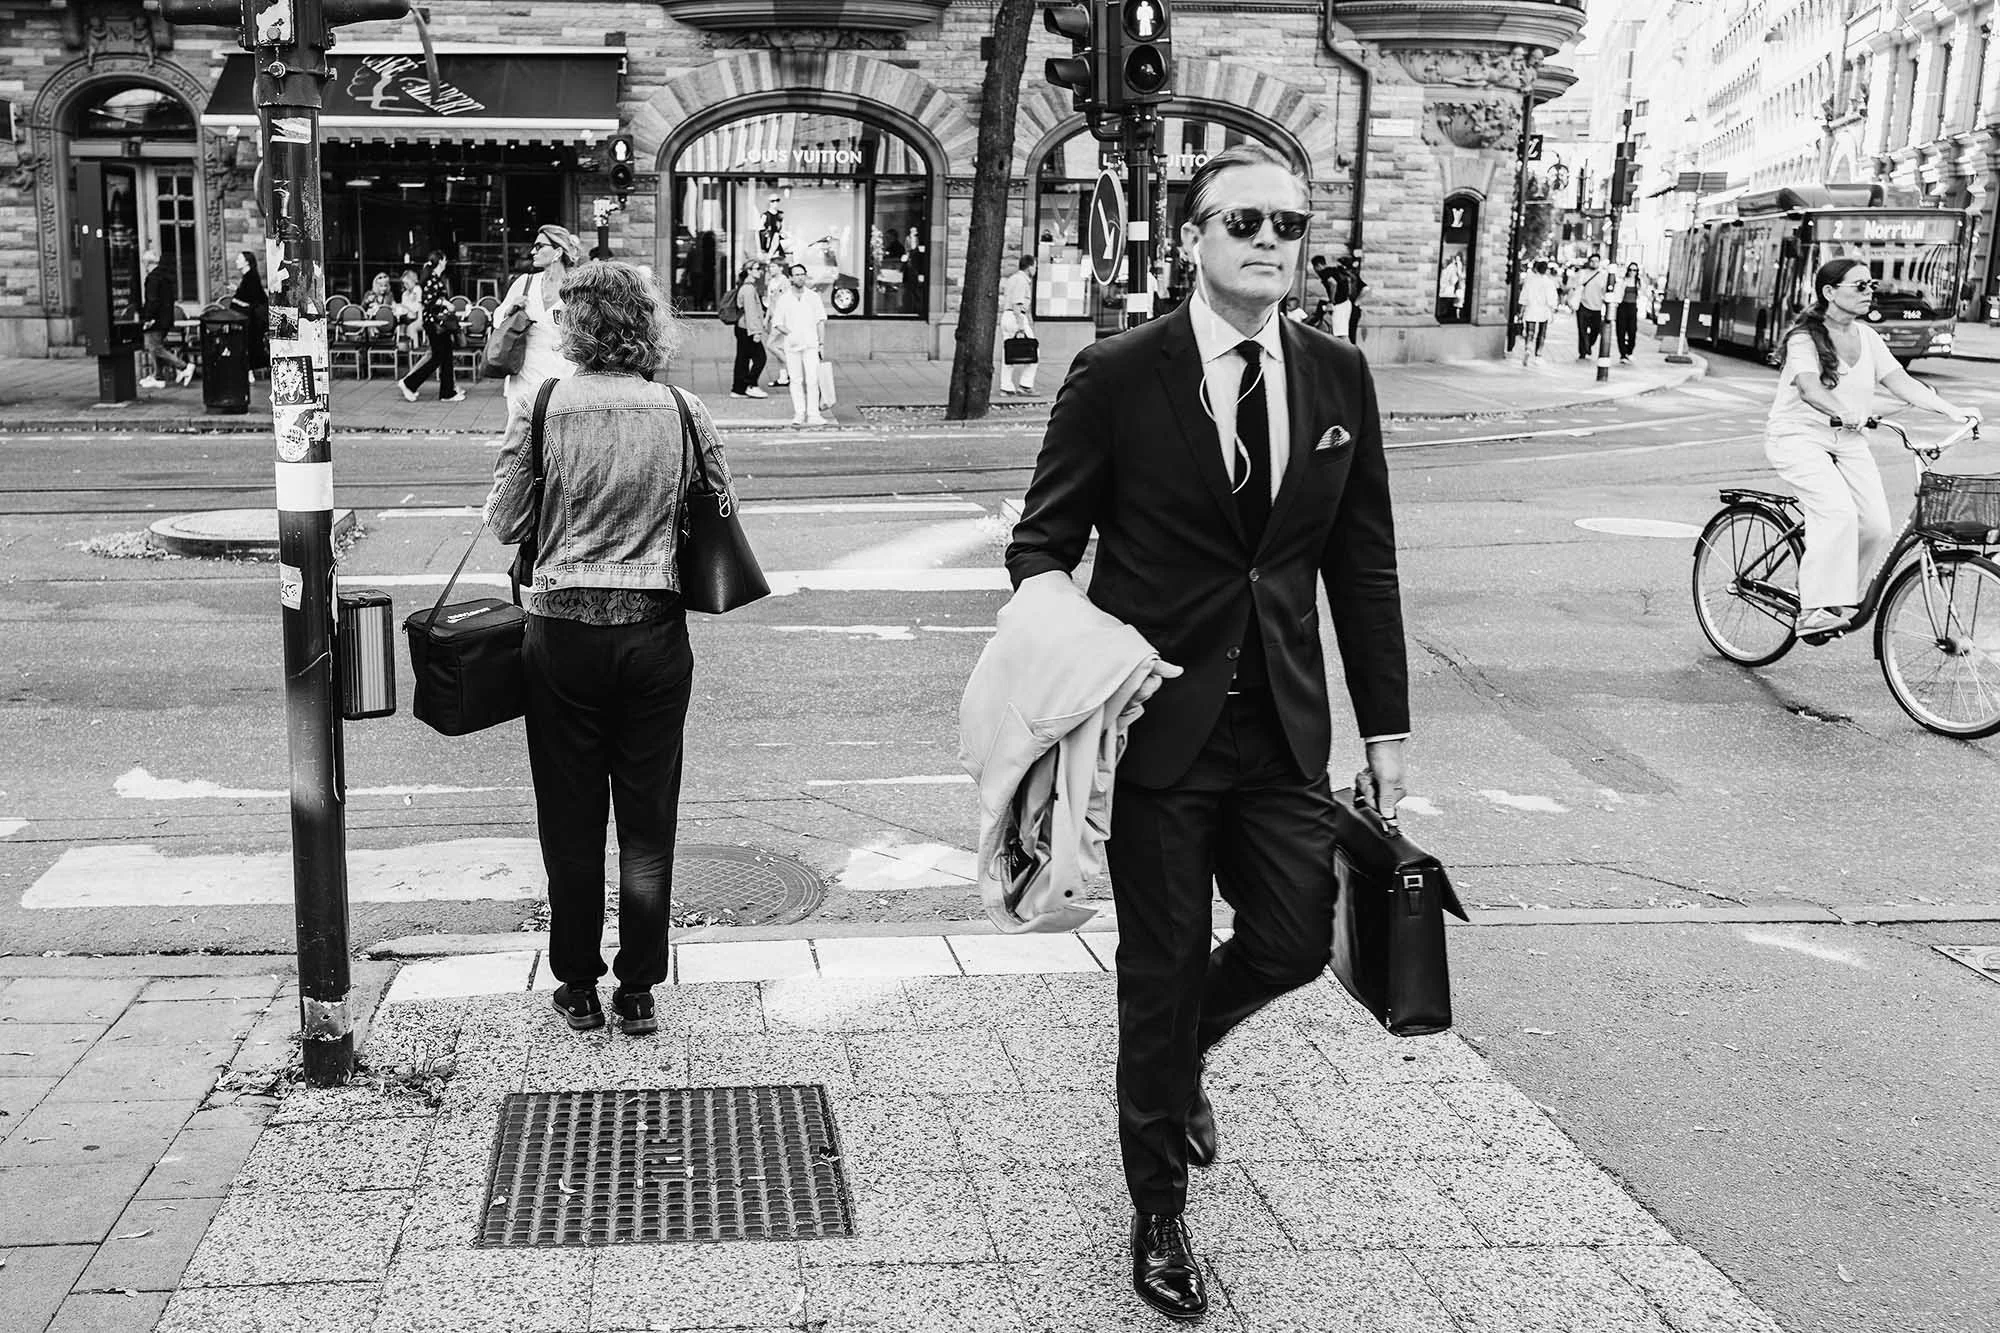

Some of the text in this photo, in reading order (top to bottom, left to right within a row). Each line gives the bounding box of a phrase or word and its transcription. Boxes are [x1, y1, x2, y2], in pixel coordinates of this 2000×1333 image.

[792, 149, 862, 164] VUITTON
[1833, 220, 1925, 239] 2 Norrtull
